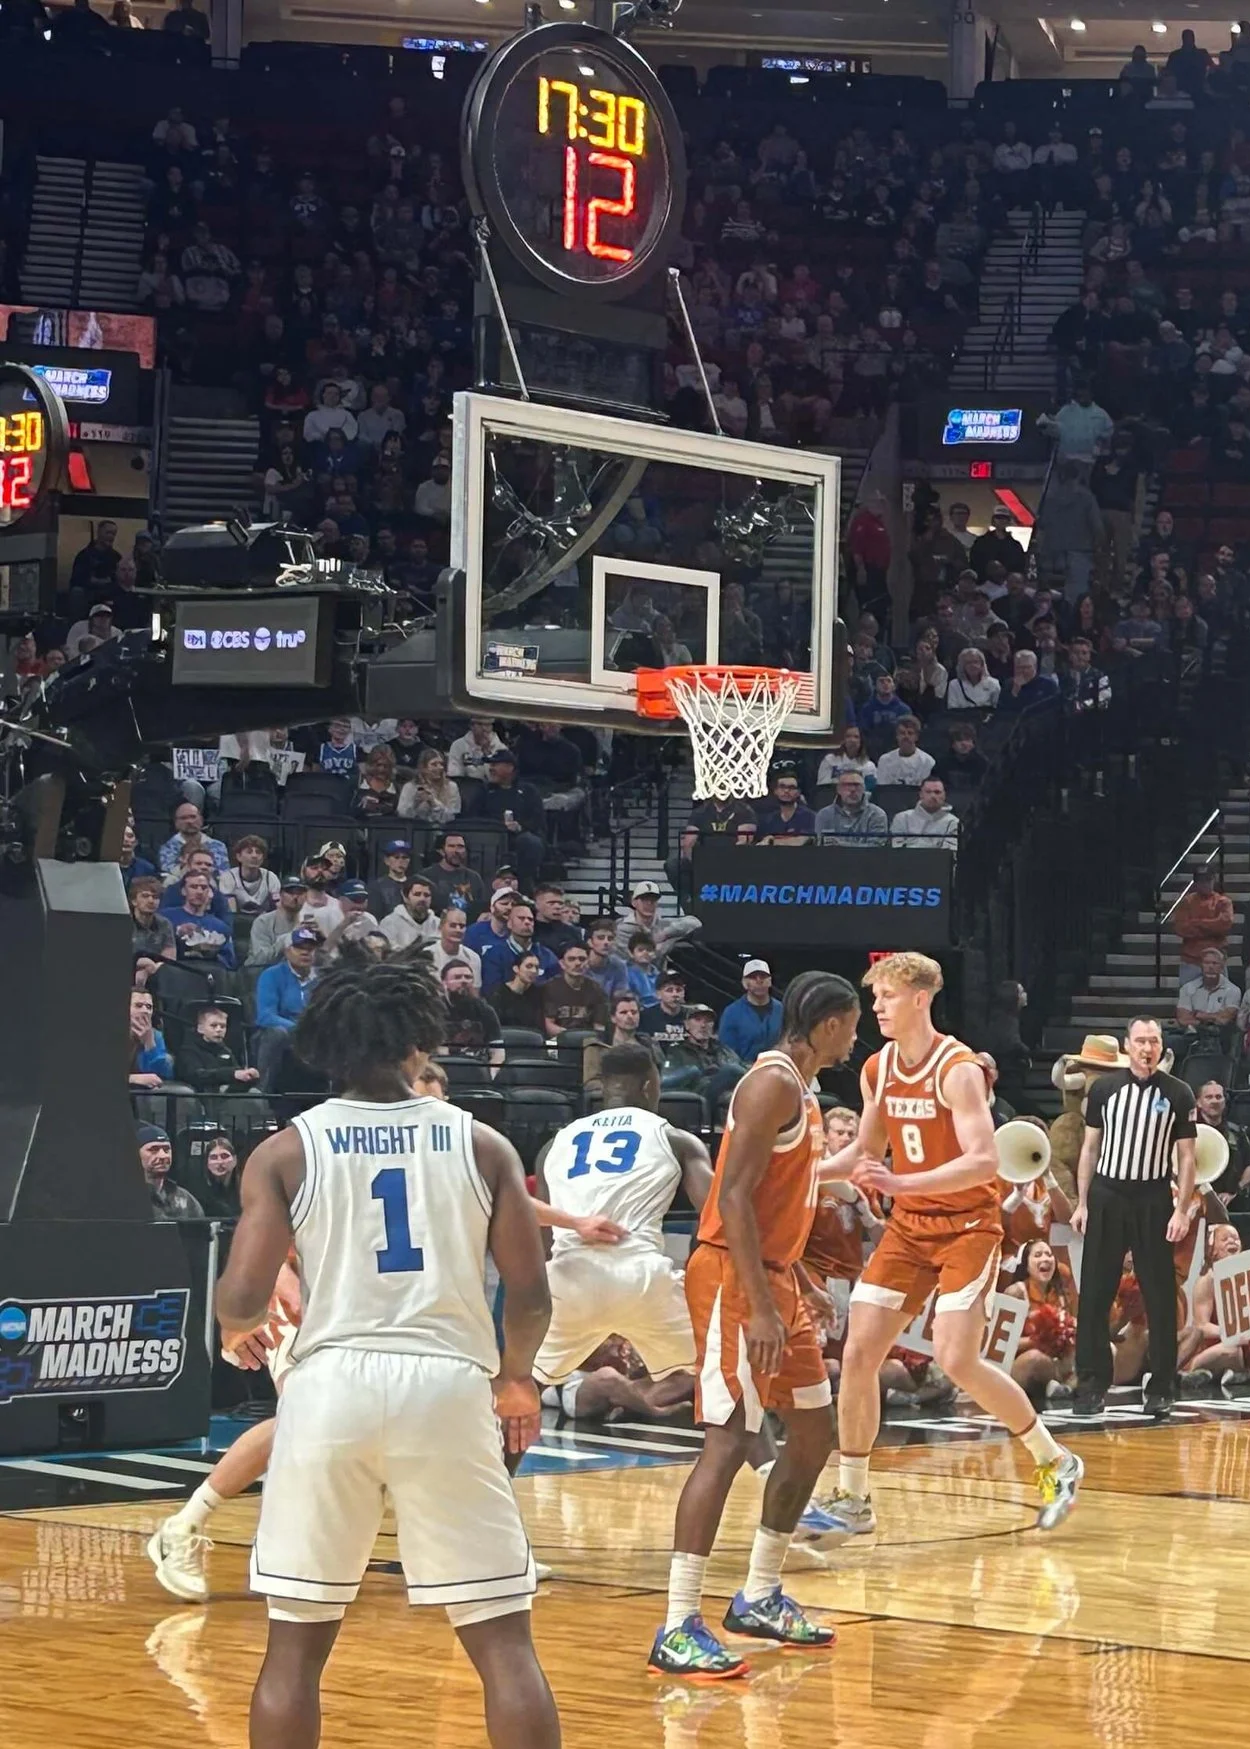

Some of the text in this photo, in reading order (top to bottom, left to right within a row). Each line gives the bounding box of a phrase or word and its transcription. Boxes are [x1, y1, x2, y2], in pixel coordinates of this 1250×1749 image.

[538, 76, 645, 155] 17:30
[564, 146, 634, 261] 12
[700, 884, 941, 907] #MARCHMADNESS
[885, 1096, 937, 1119] TEXAS
[325, 1124, 451, 1154] WRIGHT III
[567, 1131, 642, 1179] 13
[901, 1124, 925, 1163] 8
[371, 1168, 424, 1274] 1
[28, 1304, 133, 1342] MARCH
[40, 1338, 181, 1380] MADNESS
